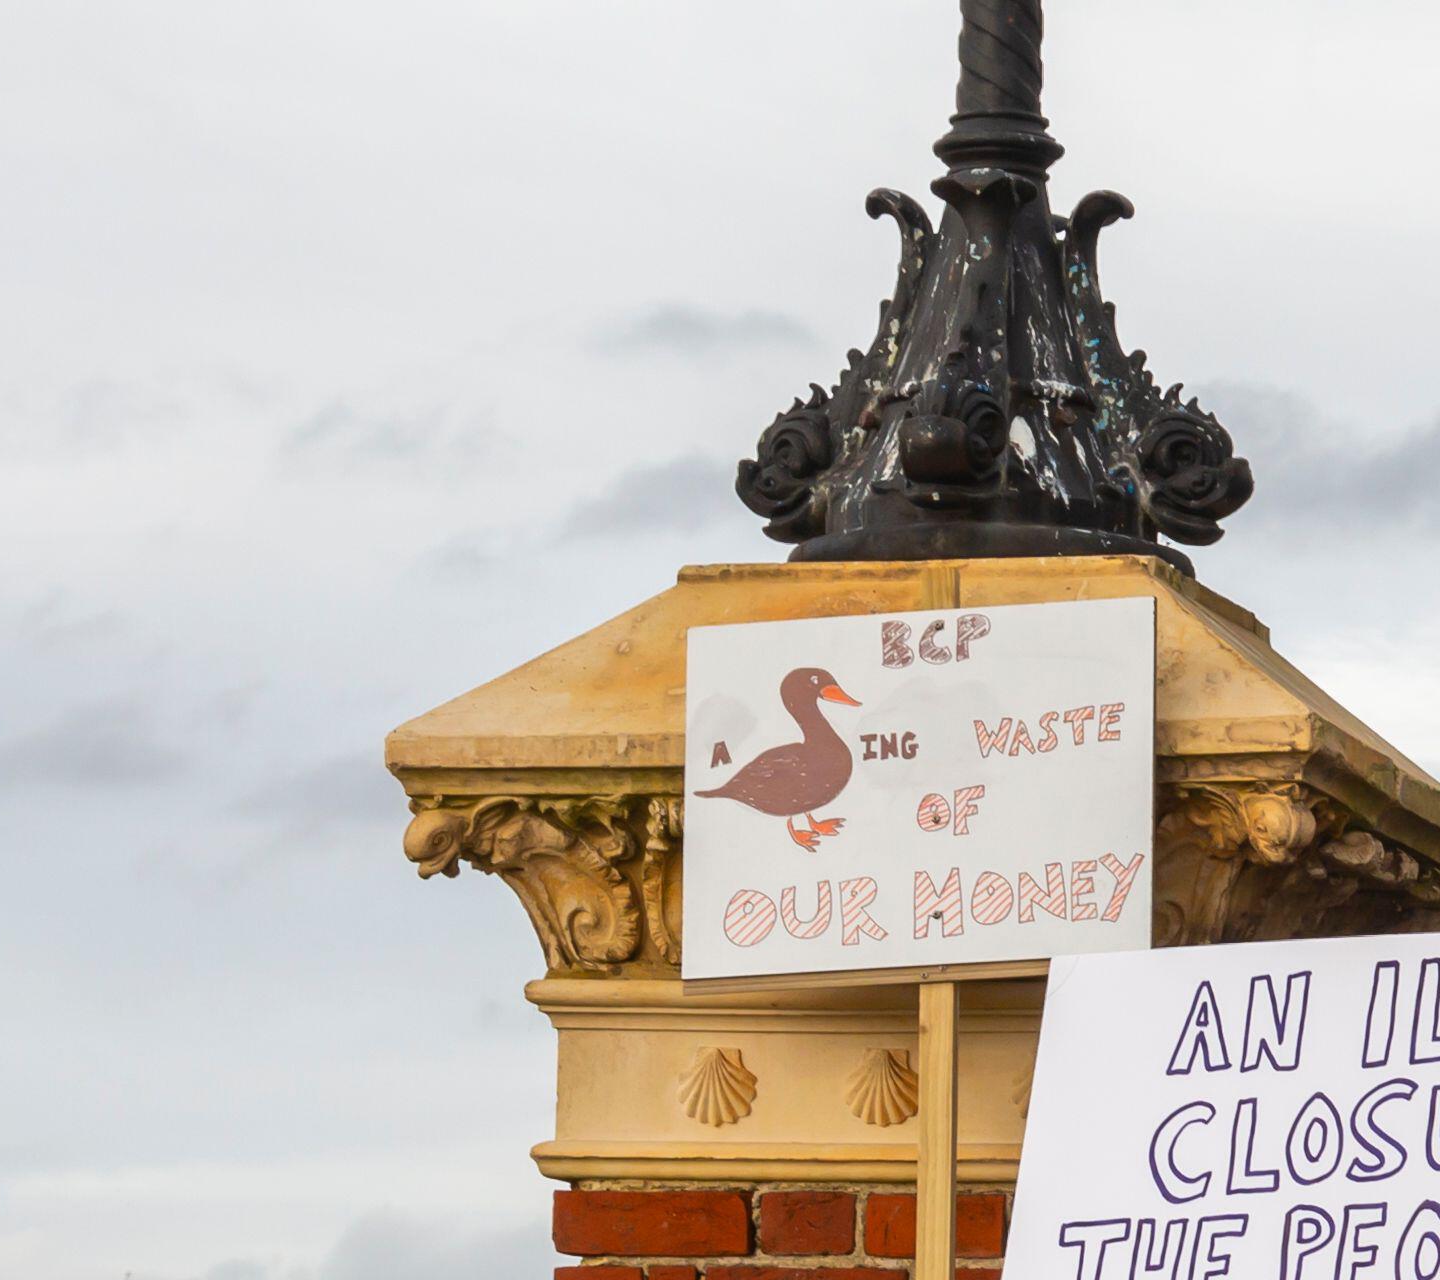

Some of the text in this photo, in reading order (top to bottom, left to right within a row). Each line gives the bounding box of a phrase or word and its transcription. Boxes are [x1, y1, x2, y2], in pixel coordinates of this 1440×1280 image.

[881, 613, 991, 668] BCP
[710, 702, 1125, 769] A ING WASTE
[916, 784, 986, 836] OF
[723, 853, 1145, 947] OUR MONEY
[1166, 970, 1313, 1076] AN
